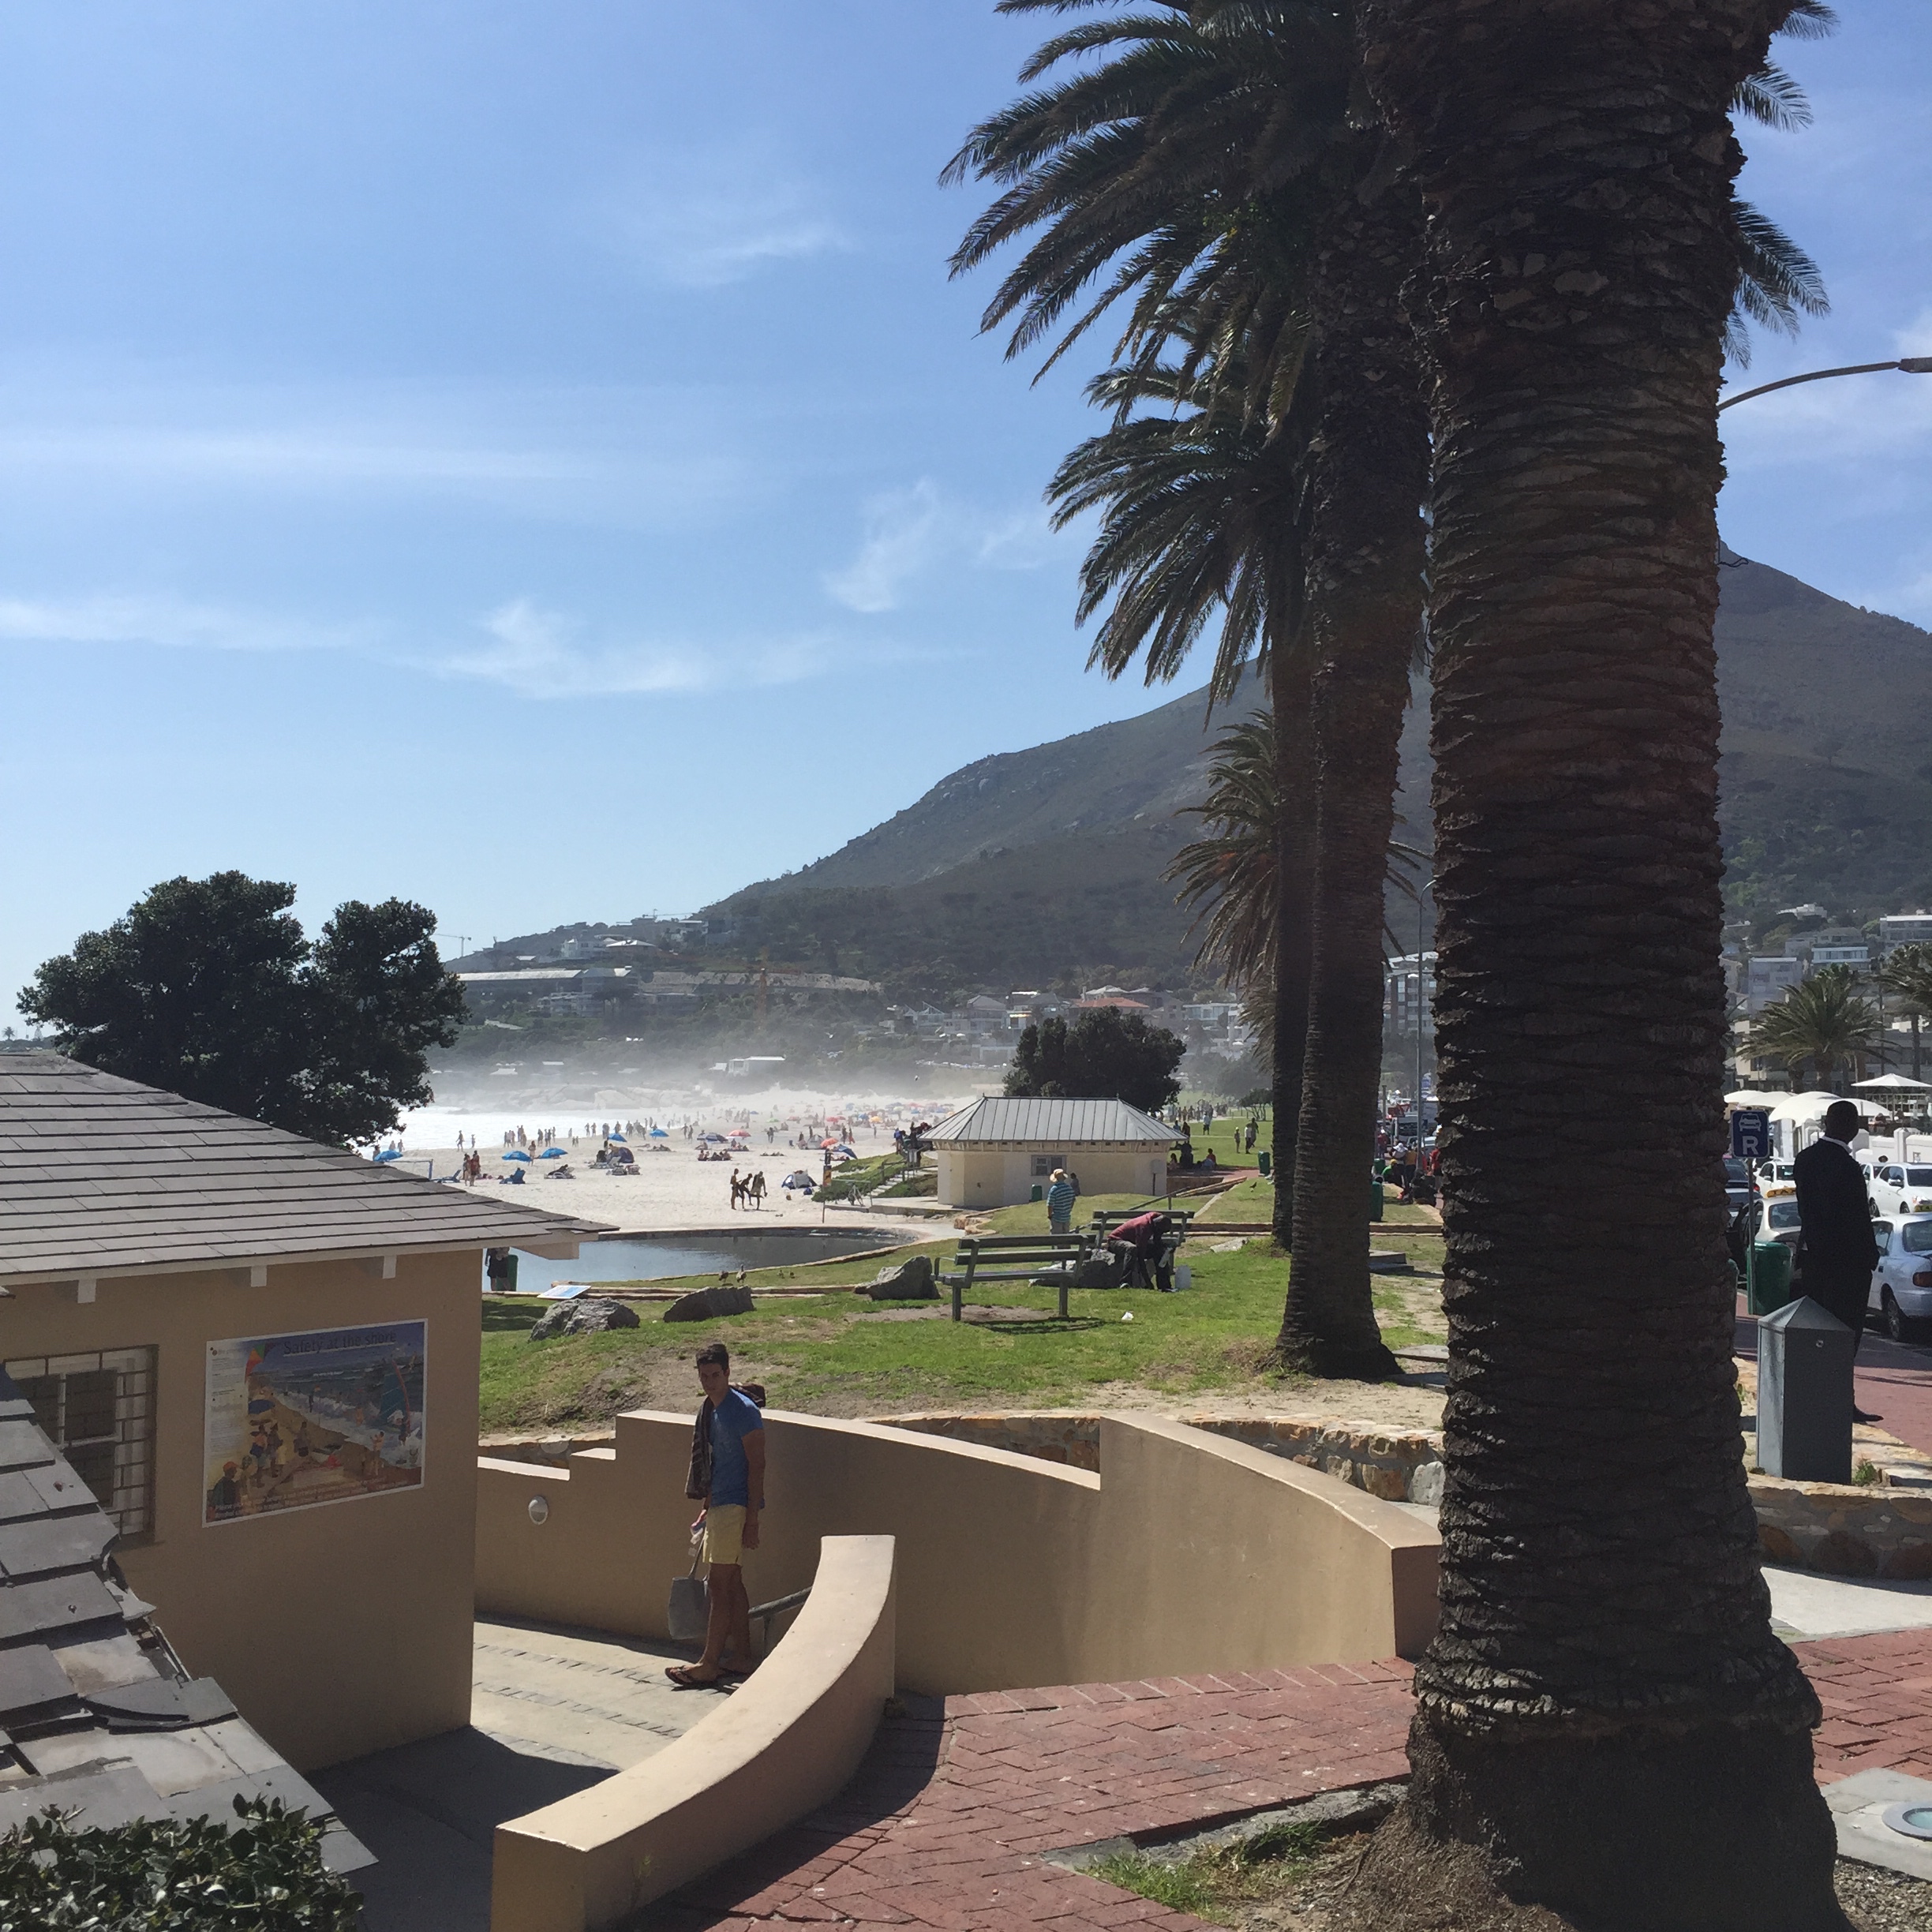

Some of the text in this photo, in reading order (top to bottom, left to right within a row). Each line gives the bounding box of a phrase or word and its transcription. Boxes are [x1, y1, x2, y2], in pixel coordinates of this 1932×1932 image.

[1742, 1135, 1759, 1155] R
[283, 1331, 396, 1355] Safety at the shore
